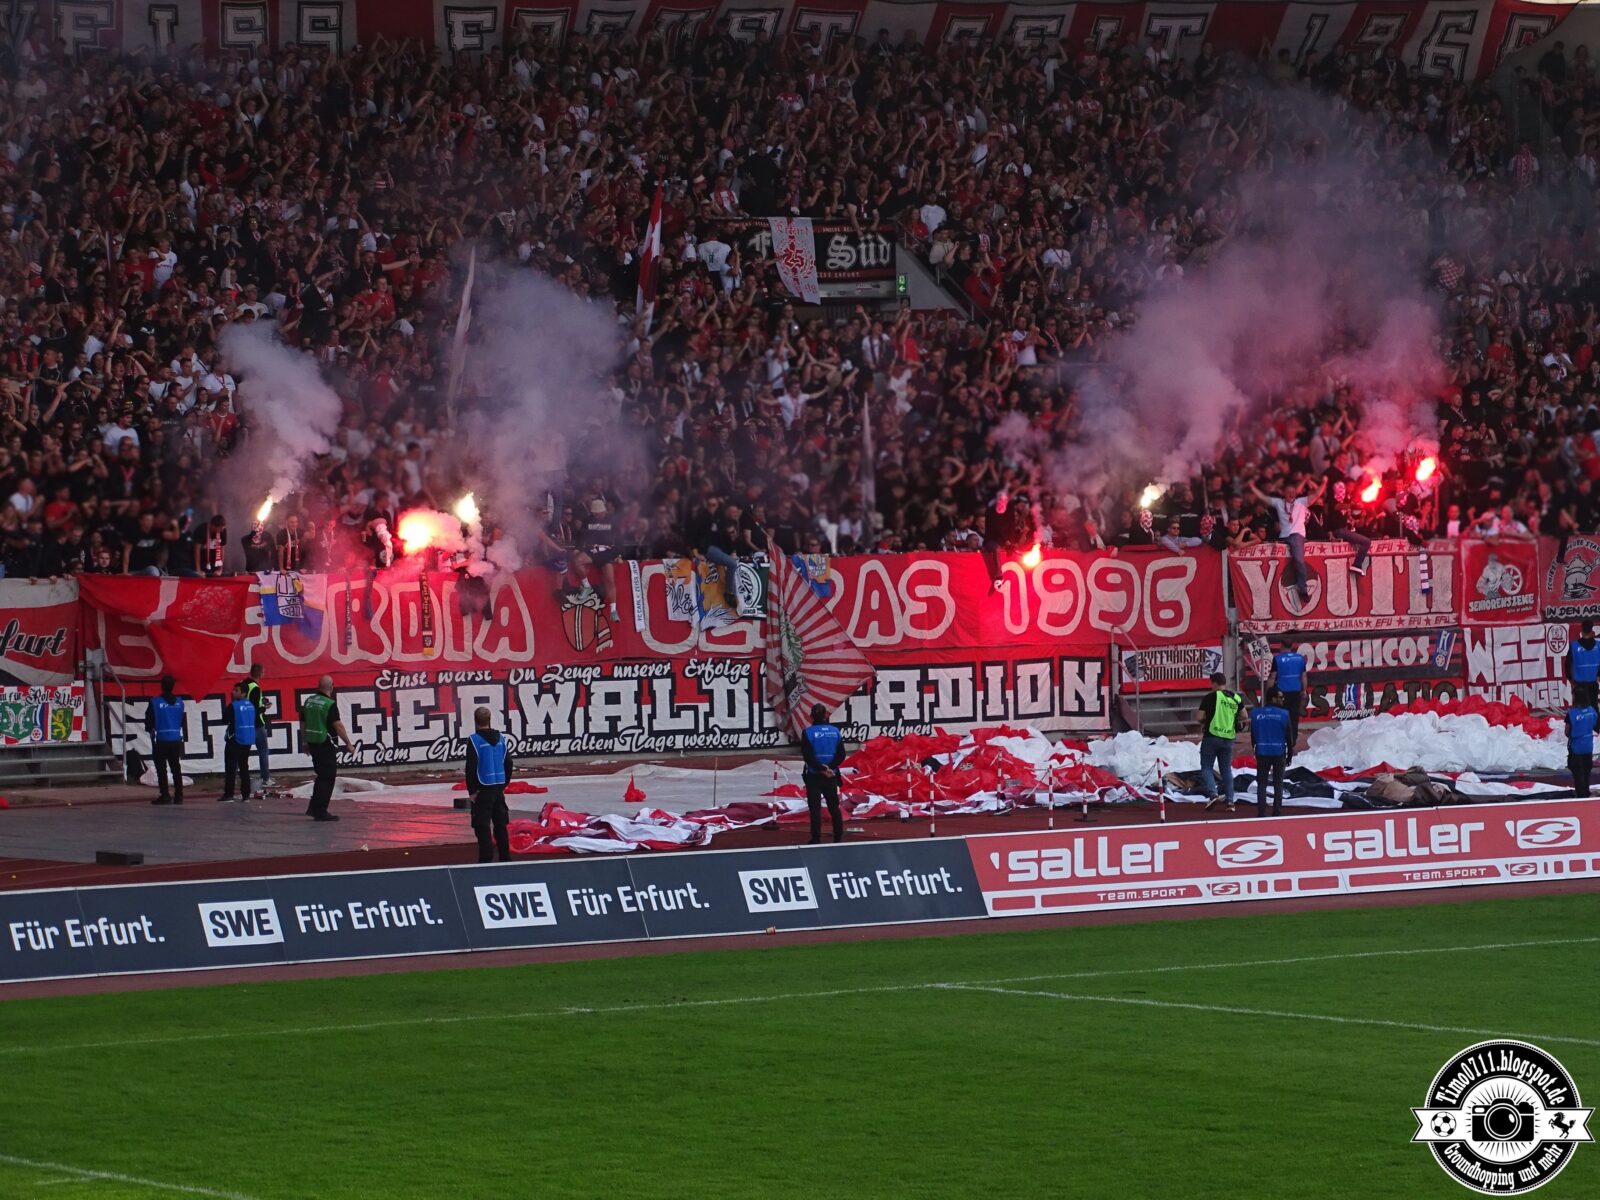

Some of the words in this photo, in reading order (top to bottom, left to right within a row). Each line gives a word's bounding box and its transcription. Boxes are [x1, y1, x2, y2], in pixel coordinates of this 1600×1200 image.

[826, 233, 891, 270] Süd
[1376, 543, 1393, 552] EFU
[1000, 556, 1197, 638] 1996
[1236, 554, 1454, 620] YOUTH
[1303, 621, 1320, 629] EFU
[1375, 617, 1392, 626] EFU
[1408, 617, 1422, 625] EFU
[1434, 616, 1450, 624] EFU
[1546, 606, 1558, 618] IN
[1559, 605, 1581, 617] DEN
[1297, 641, 1329, 672] OS
[1334, 636, 1430, 670] CHICOS
[1463, 623, 1569, 683] WEST
[376, 669, 428, 690] Einst
[438, 668, 492, 684] warst
[509, 667, 535, 686] Du
[541, 663, 600, 686] Zeuge
[613, 662, 671, 678] unserer
[685, 657, 750, 684] Erfolge
[1332, 706, 1376, 720] Supporters
[335, 740, 363, 764] ach
[375, 741, 409, 763] dem
[427, 736, 468, 761] Gla
[506, 734, 560, 753] Deiner
[570, 733, 614, 751] alten
[619, 728, 674, 752] Tage
[684, 726, 739, 746] werden
[750, 730, 779, 746] wir
[840, 722, 869, 741] wig
[880, 717, 932, 737] sehnen
[567, 886, 613, 917] Für
[617, 881, 710, 914] Erfurt.
[749, 873, 810, 905] SWE
[827, 871, 872, 902] Für
[879, 865, 963, 898] Erfurt.
[209, 907, 275, 940] SWE
[295, 903, 344, 934] Für
[347, 898, 444, 931] Erfurt.
[488, 889, 548, 922] SWE
[9, 921, 60, 952] Für
[65, 914, 166, 949] Erfurt.
